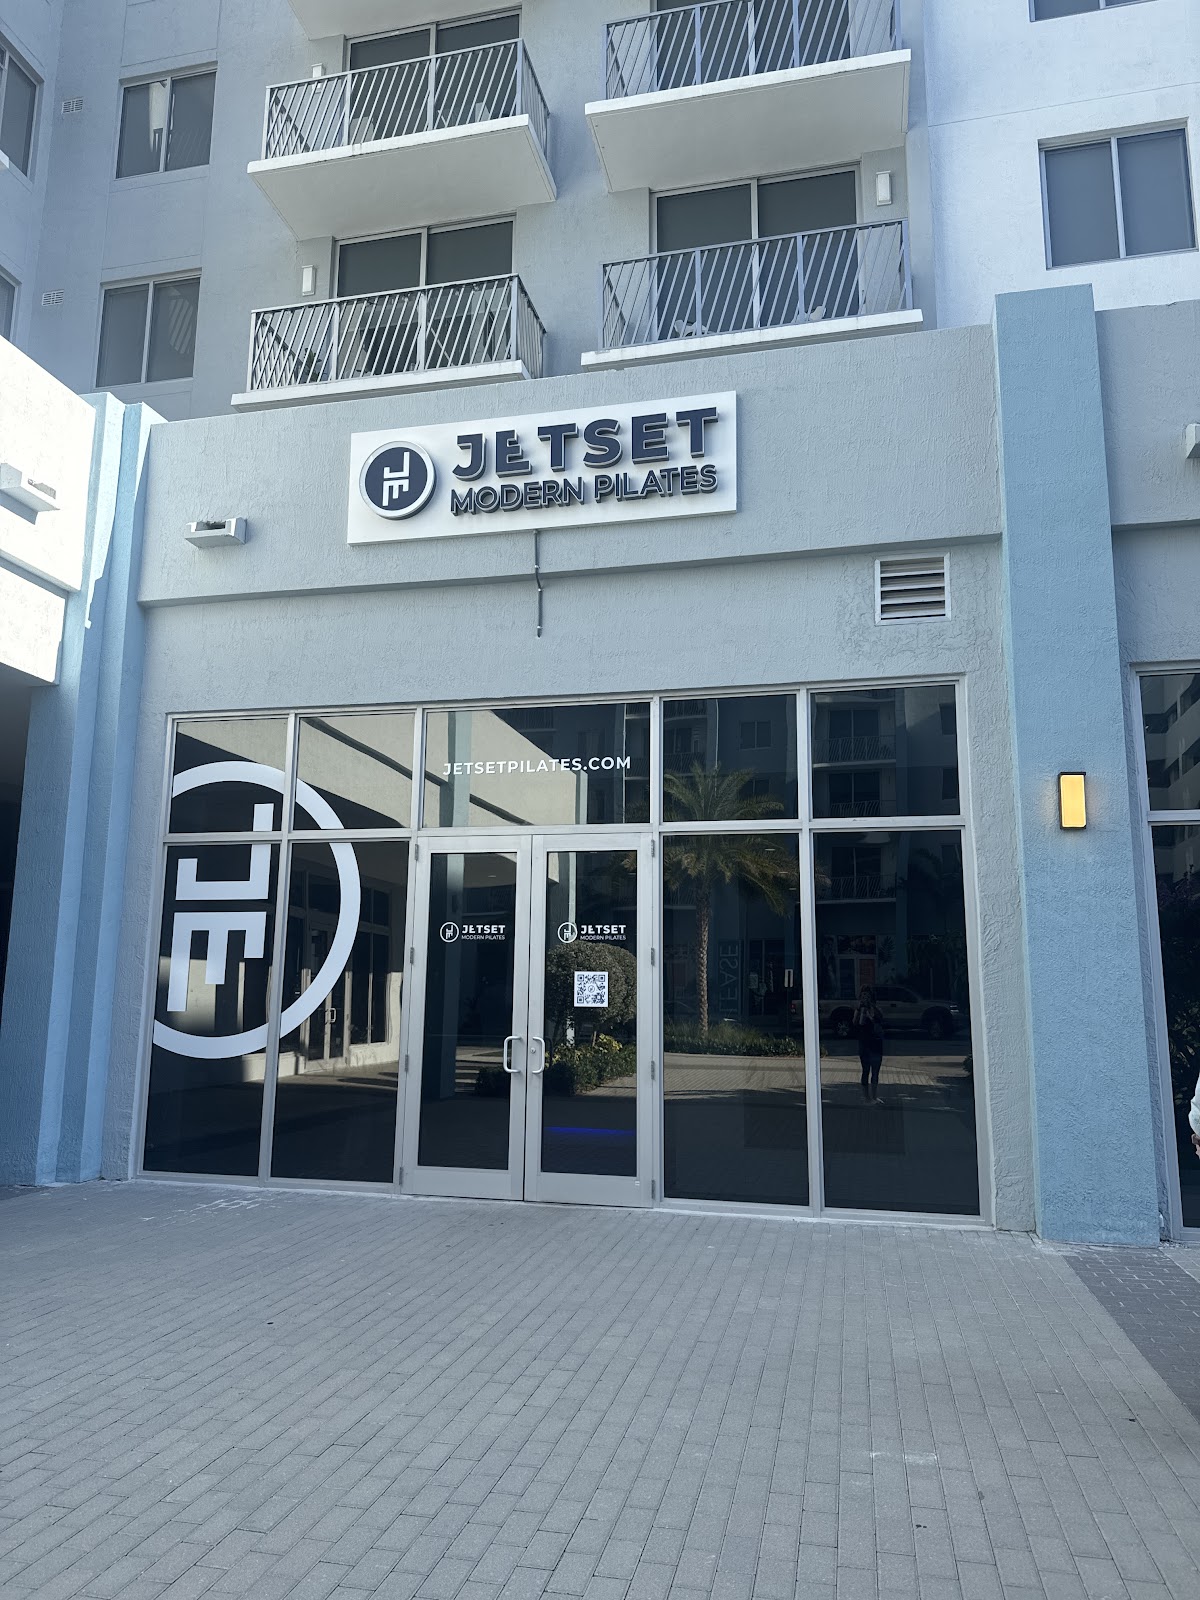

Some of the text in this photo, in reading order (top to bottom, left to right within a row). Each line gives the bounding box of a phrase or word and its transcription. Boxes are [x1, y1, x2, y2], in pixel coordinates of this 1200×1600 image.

[452, 406, 720, 481] JETSET
[450, 464, 719, 516] MODERN PILATES
[443, 756, 631, 776] JETSETPILATES.COM
[461, 924, 506, 934] JETSET
[580, 924, 627, 935] JETSET
